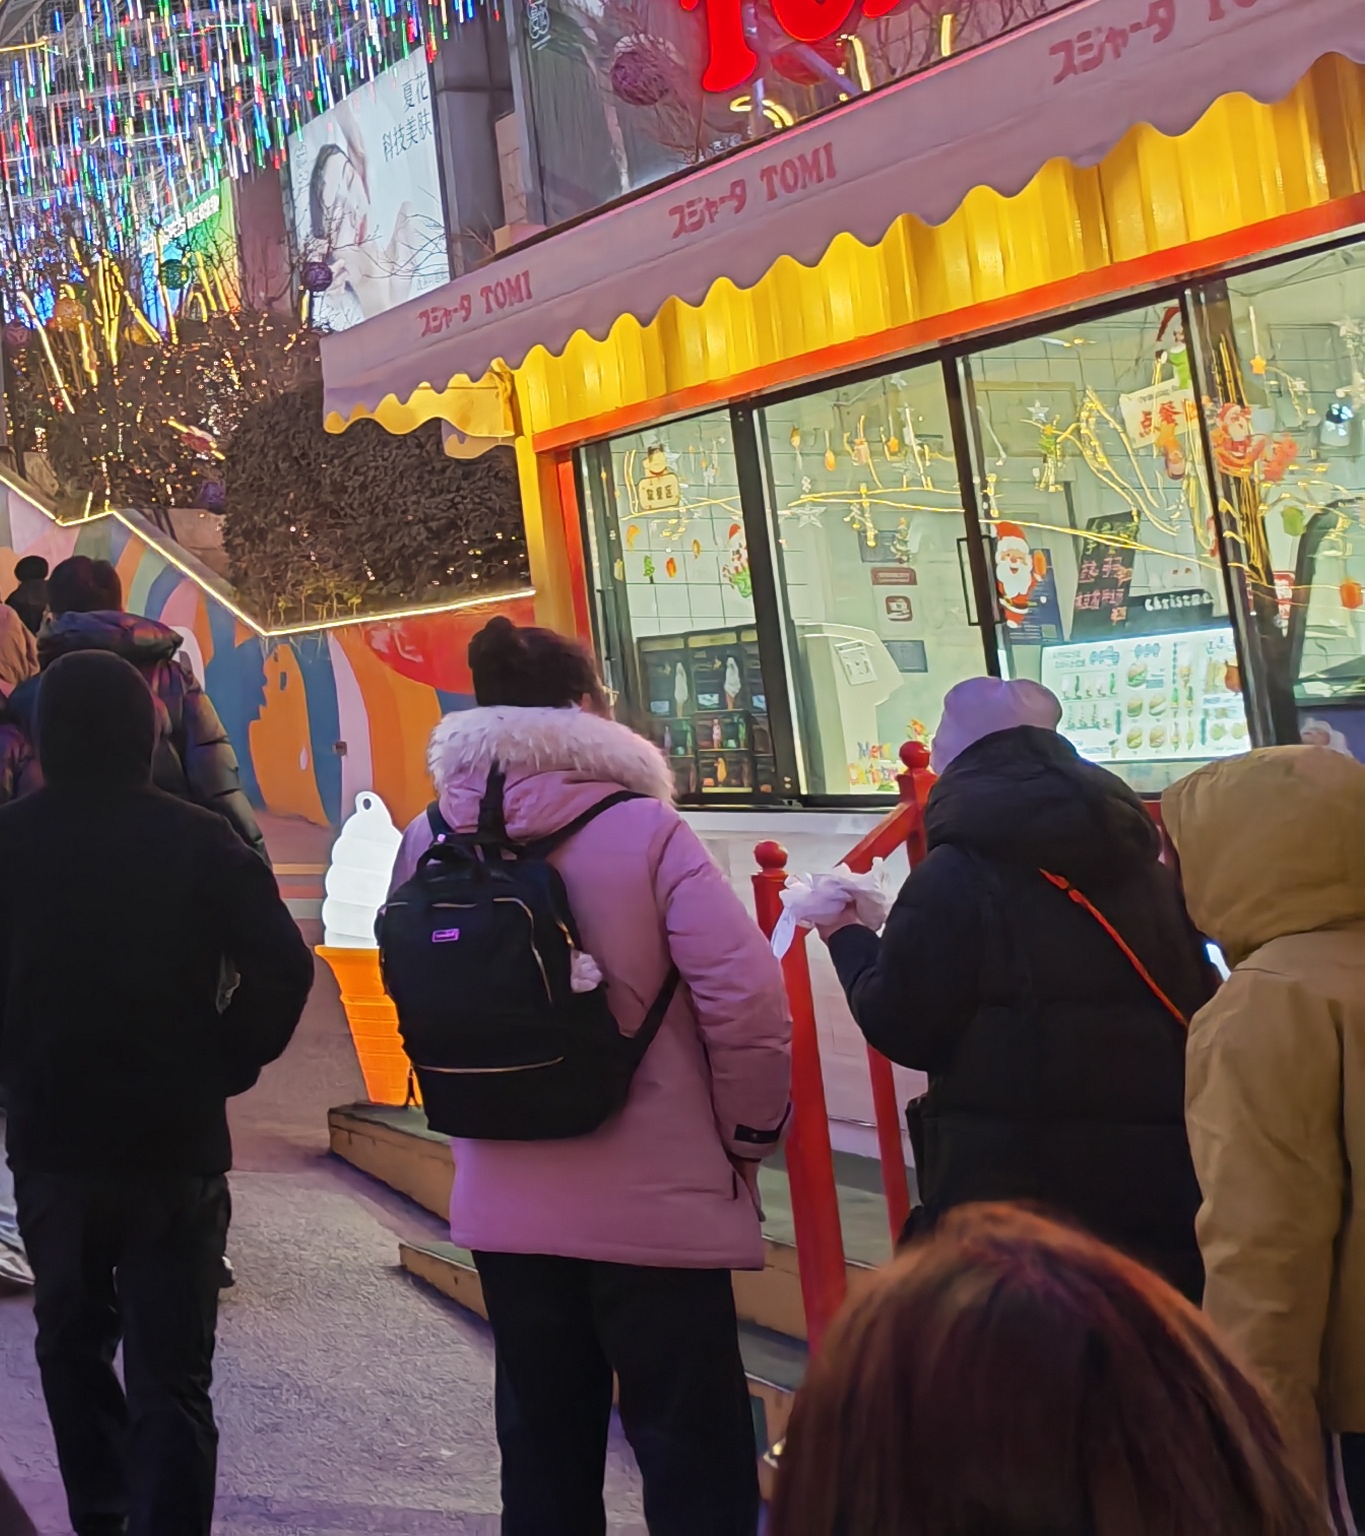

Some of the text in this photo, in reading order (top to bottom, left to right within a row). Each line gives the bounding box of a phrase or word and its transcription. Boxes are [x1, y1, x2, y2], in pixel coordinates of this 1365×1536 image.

[402, 70, 429, 113] 夏花
[381, 108, 433, 163] 科技美肤
[668, 178, 747, 240] スジャータ
[759, 141, 837, 202] TOMI
[479, 269, 533, 314] TOMI
